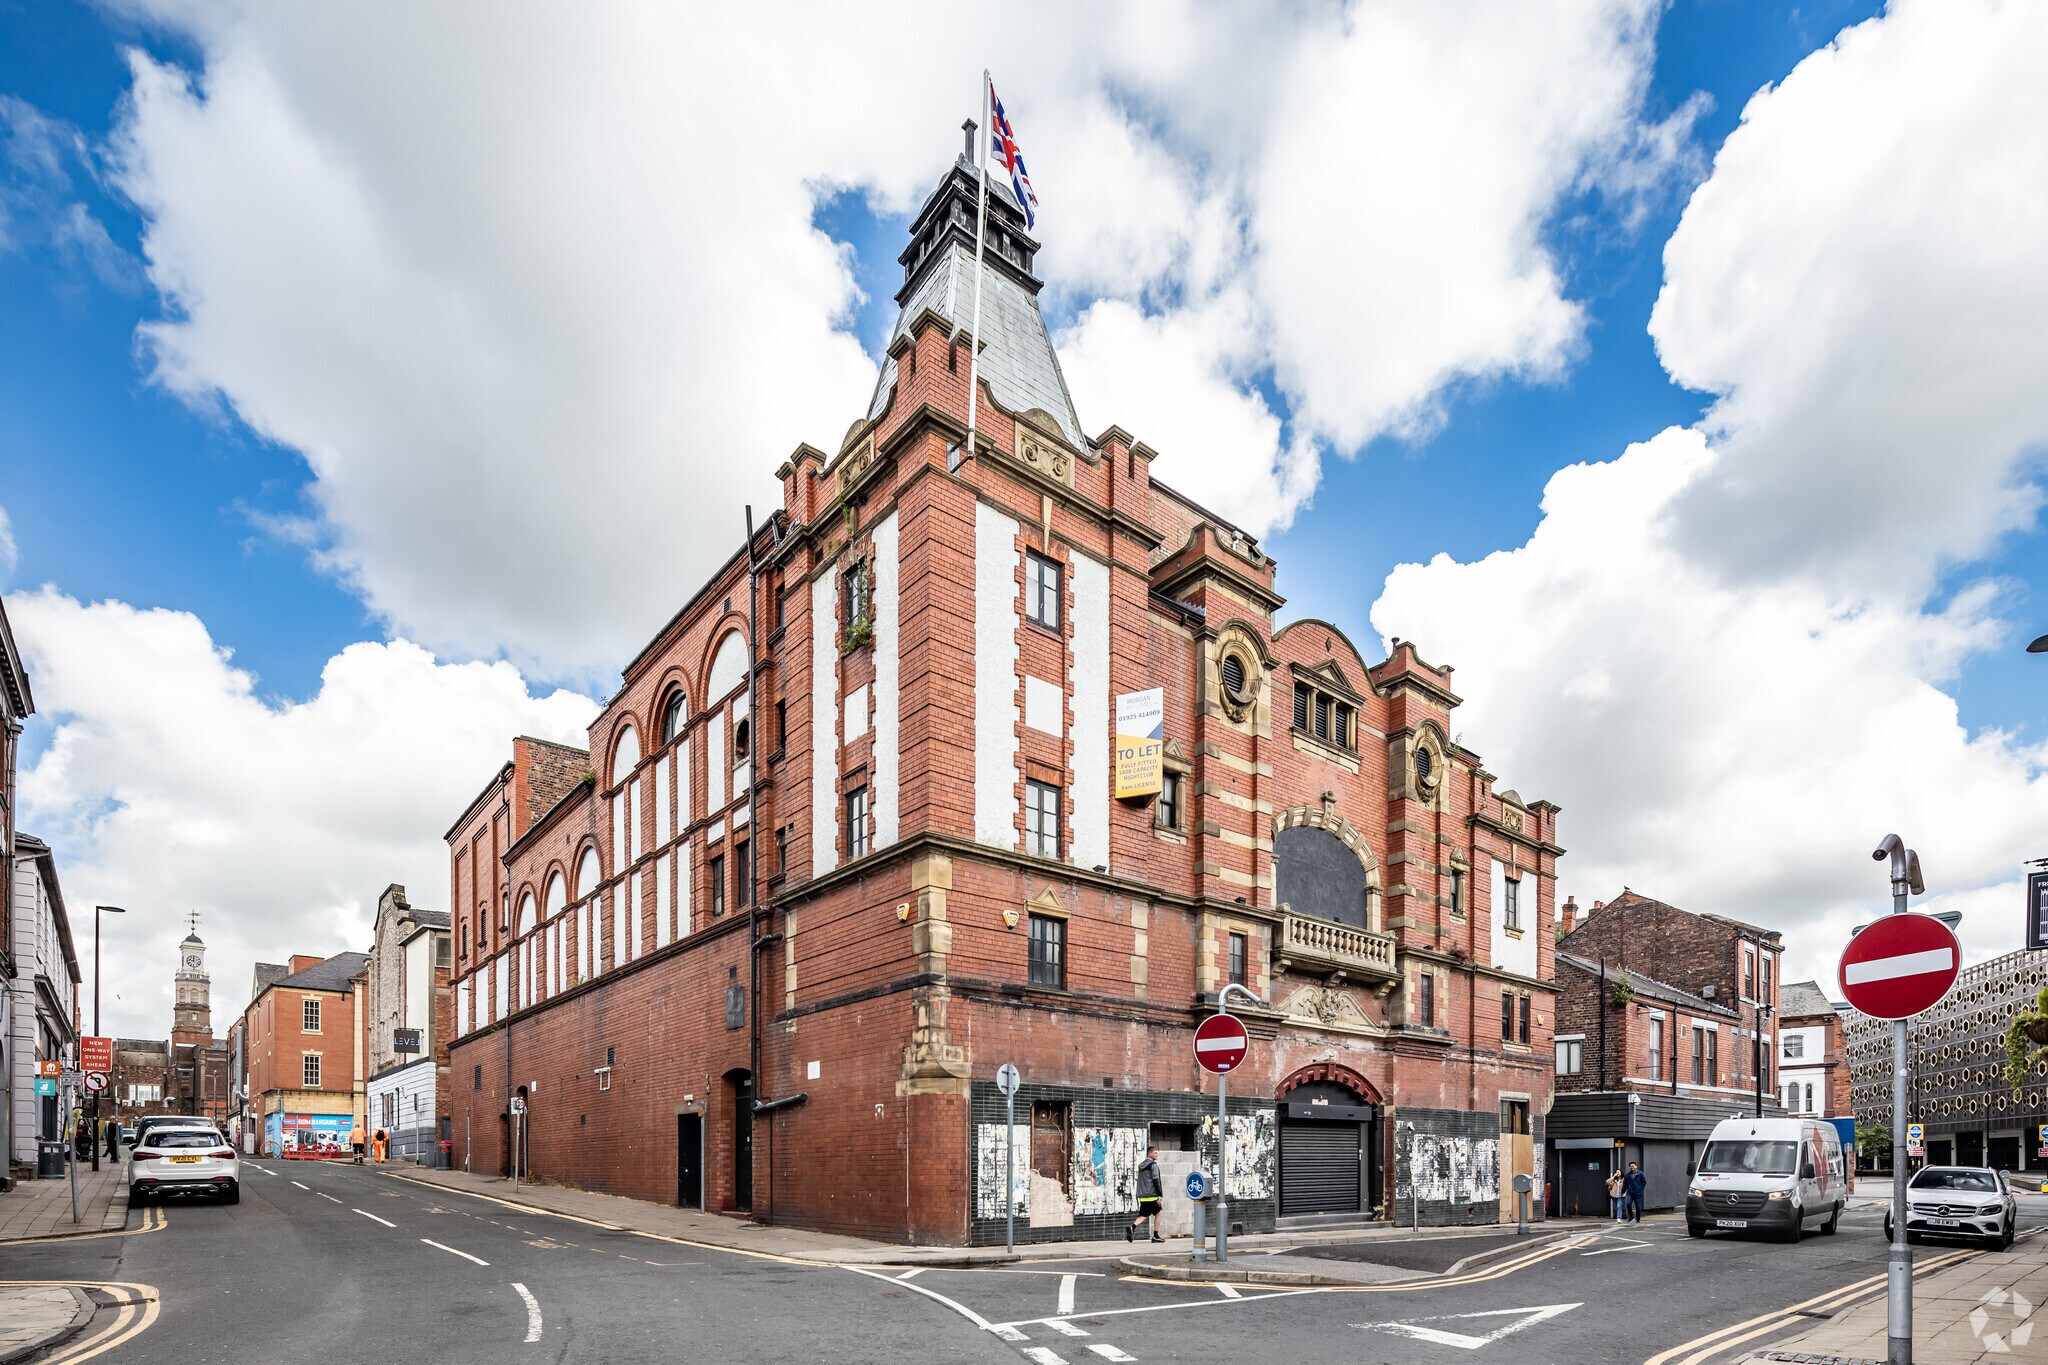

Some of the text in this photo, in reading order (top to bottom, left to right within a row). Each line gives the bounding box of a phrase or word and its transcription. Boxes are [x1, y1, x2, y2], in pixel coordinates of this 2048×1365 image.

[1127, 695, 1150, 704] MORGAN
[1138, 710, 1160, 718] 414909
[1117, 744, 1161, 760] TO LET
[1133, 765, 1158, 773] CAPACITY
[1124, 772, 1154, 780] NIGHTCLUB
[394, 1037, 420, 1046] LEVEL
